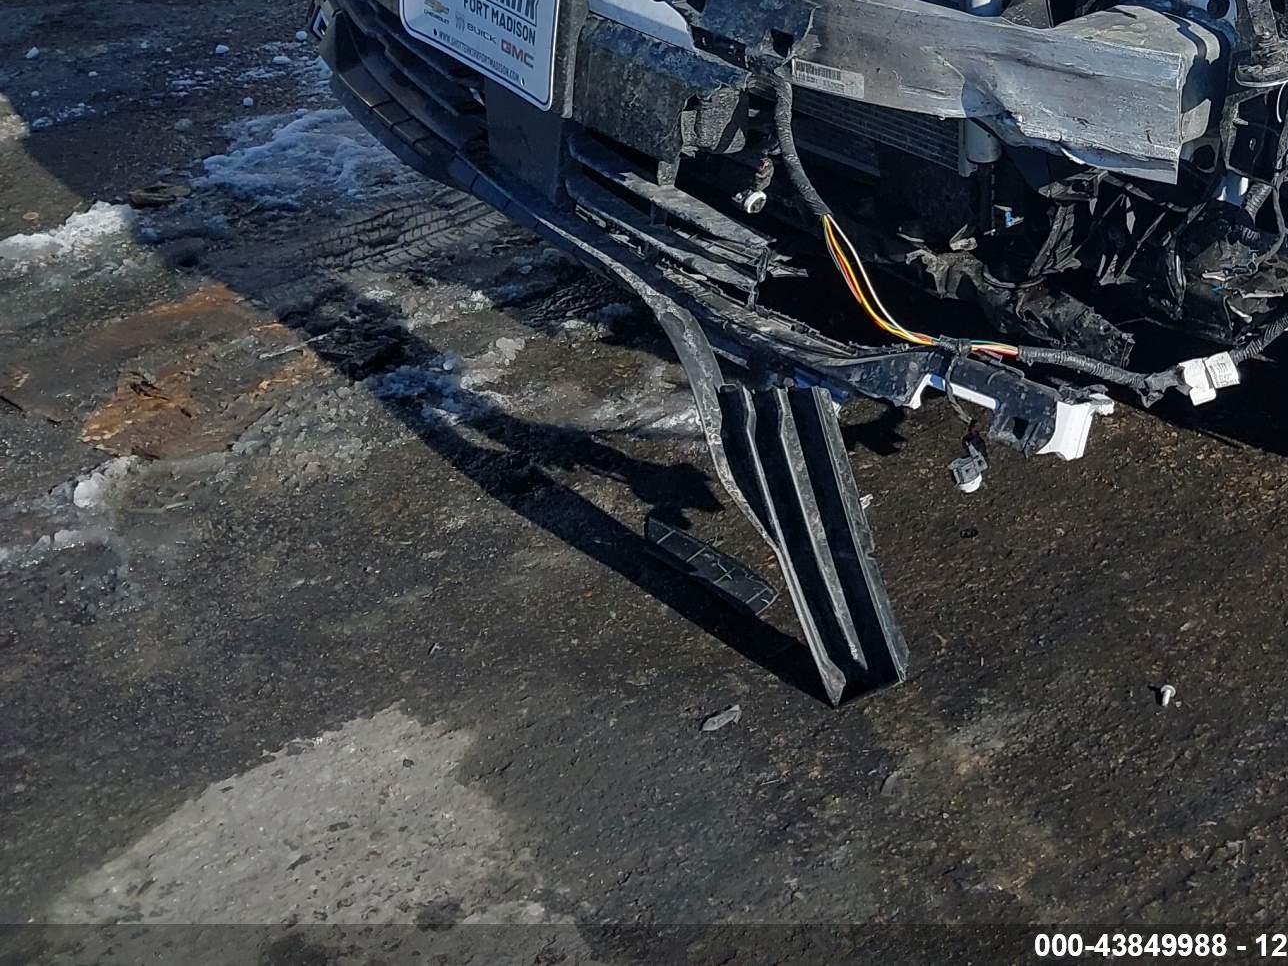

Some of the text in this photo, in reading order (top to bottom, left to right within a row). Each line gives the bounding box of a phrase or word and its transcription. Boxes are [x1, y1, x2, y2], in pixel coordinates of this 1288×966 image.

[466, 22, 497, 44] BUICK
[491, 9, 536, 47] MADISON
[500, 38, 535, 69] GMC
